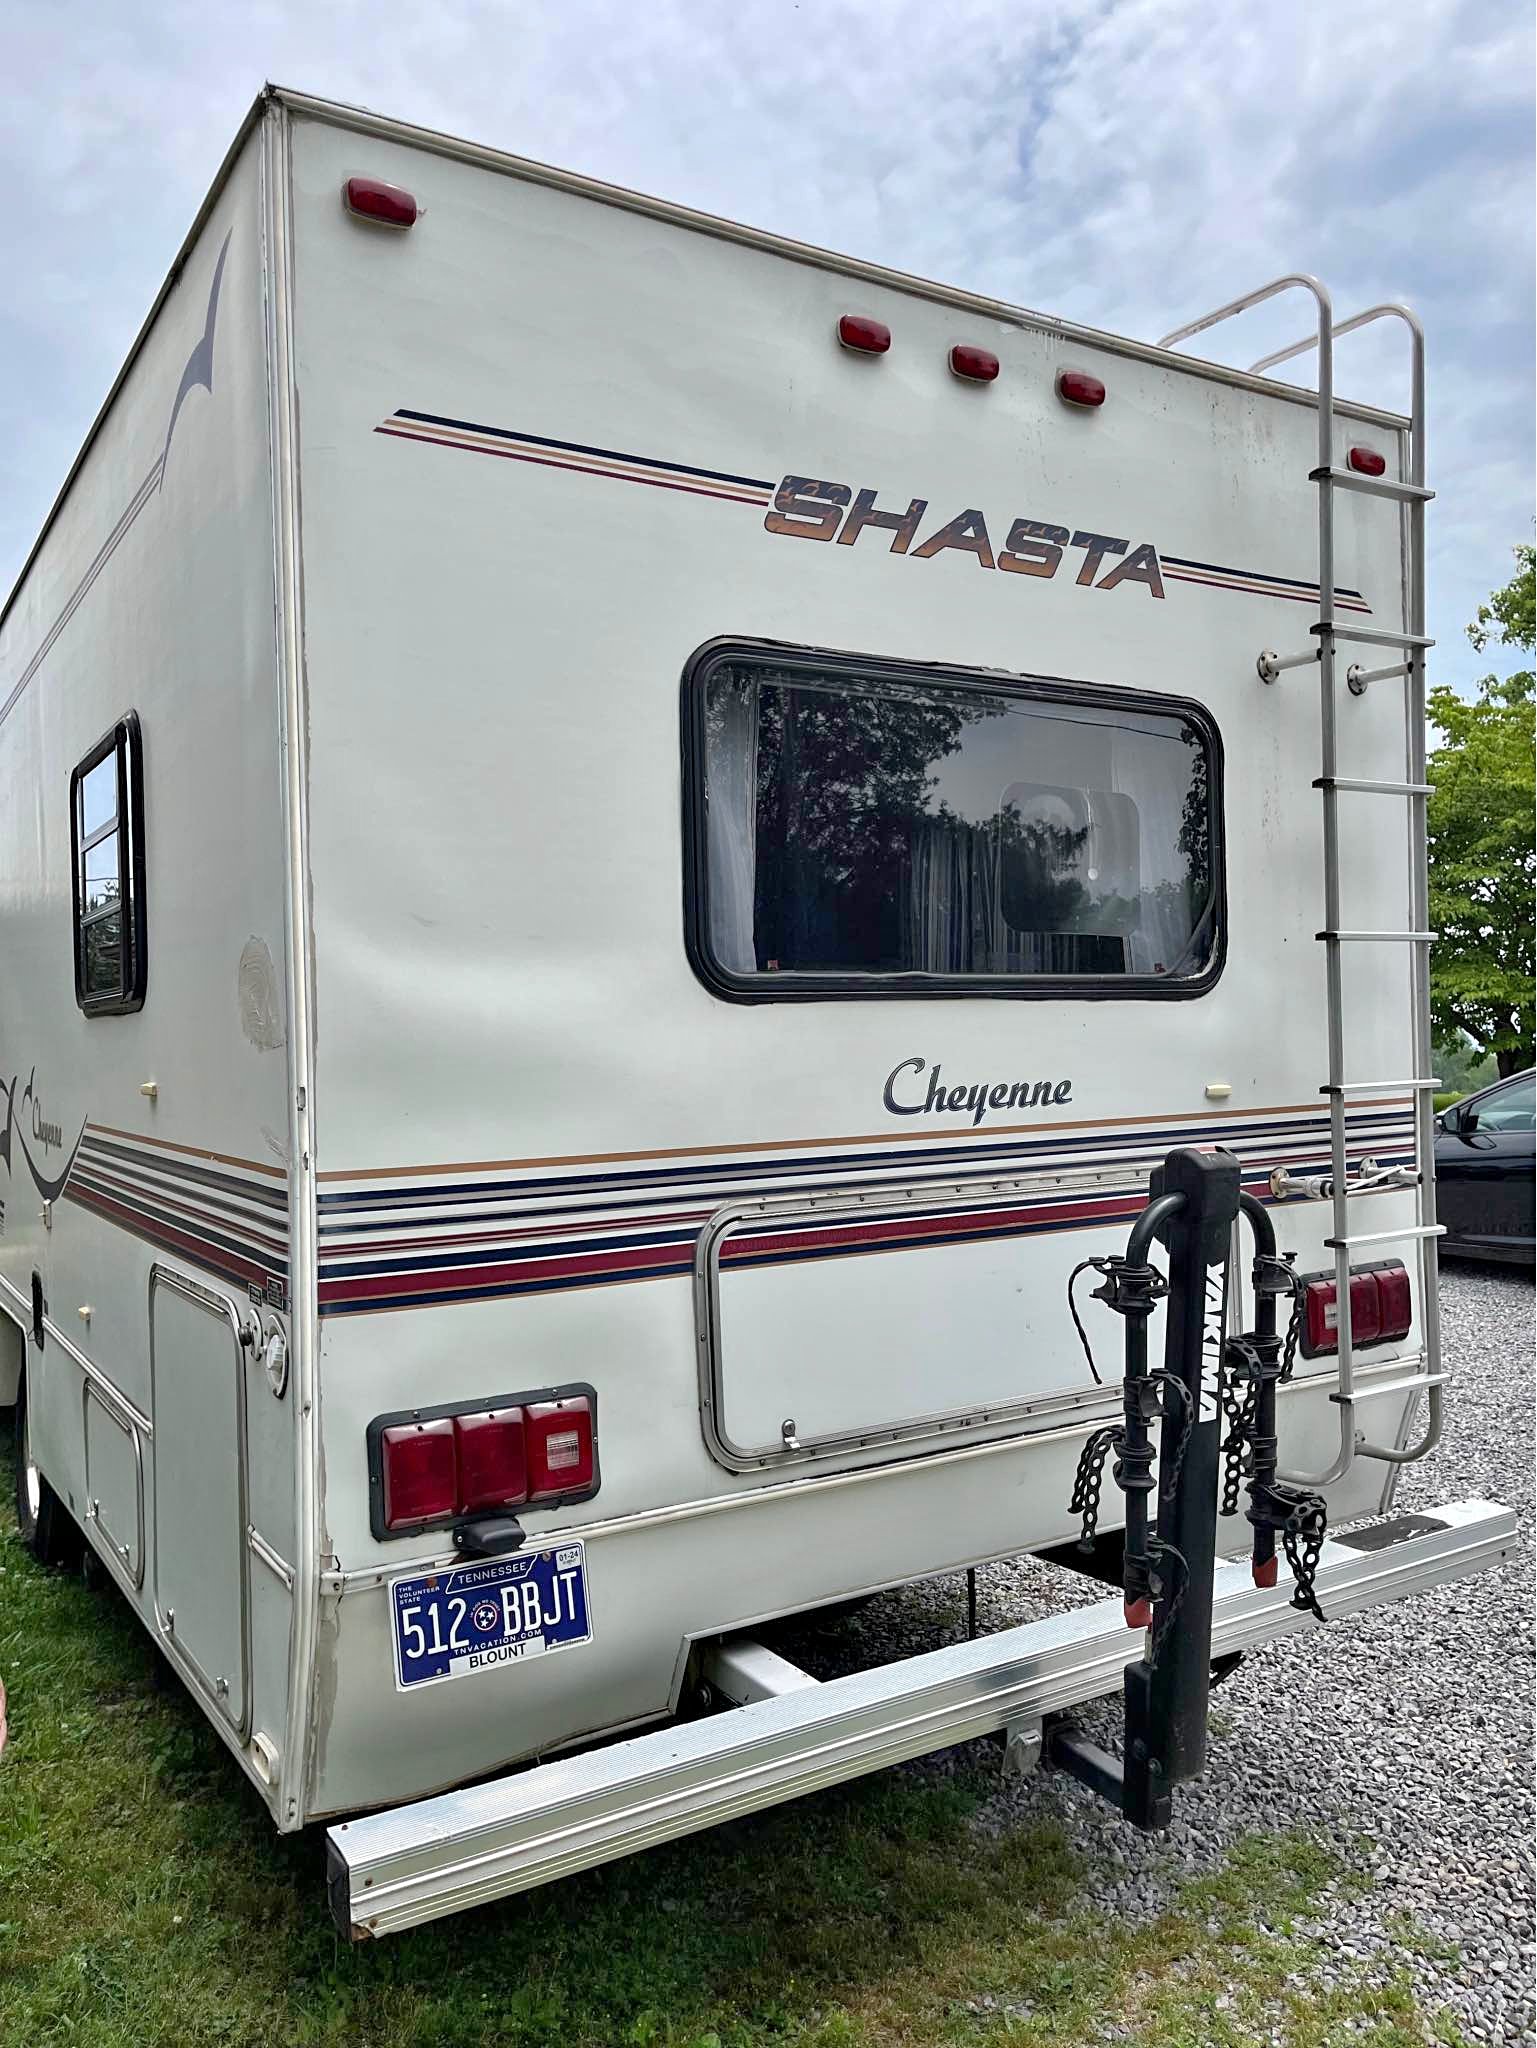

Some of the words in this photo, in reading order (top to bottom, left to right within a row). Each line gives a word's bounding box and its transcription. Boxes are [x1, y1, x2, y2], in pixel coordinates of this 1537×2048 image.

[764, 474, 1165, 599] SHASTA
[883, 1057, 1073, 1127] Cheyenne
[1199, 1260, 1225, 1423] YAKIMA
[559, 1550, 578, 1562] 01-24
[458, 1561, 528, 1585] TENNESSEE
[399, 1586, 440, 1599] VOLUNTEER
[400, 1597, 421, 1605] STATE
[402, 1597, 470, 1659] 512
[500, 1571, 578, 1637] BBJT
[454, 1628, 543, 1656] TNVACATION.COM
[469, 1643, 527, 1669] BLOUNT
